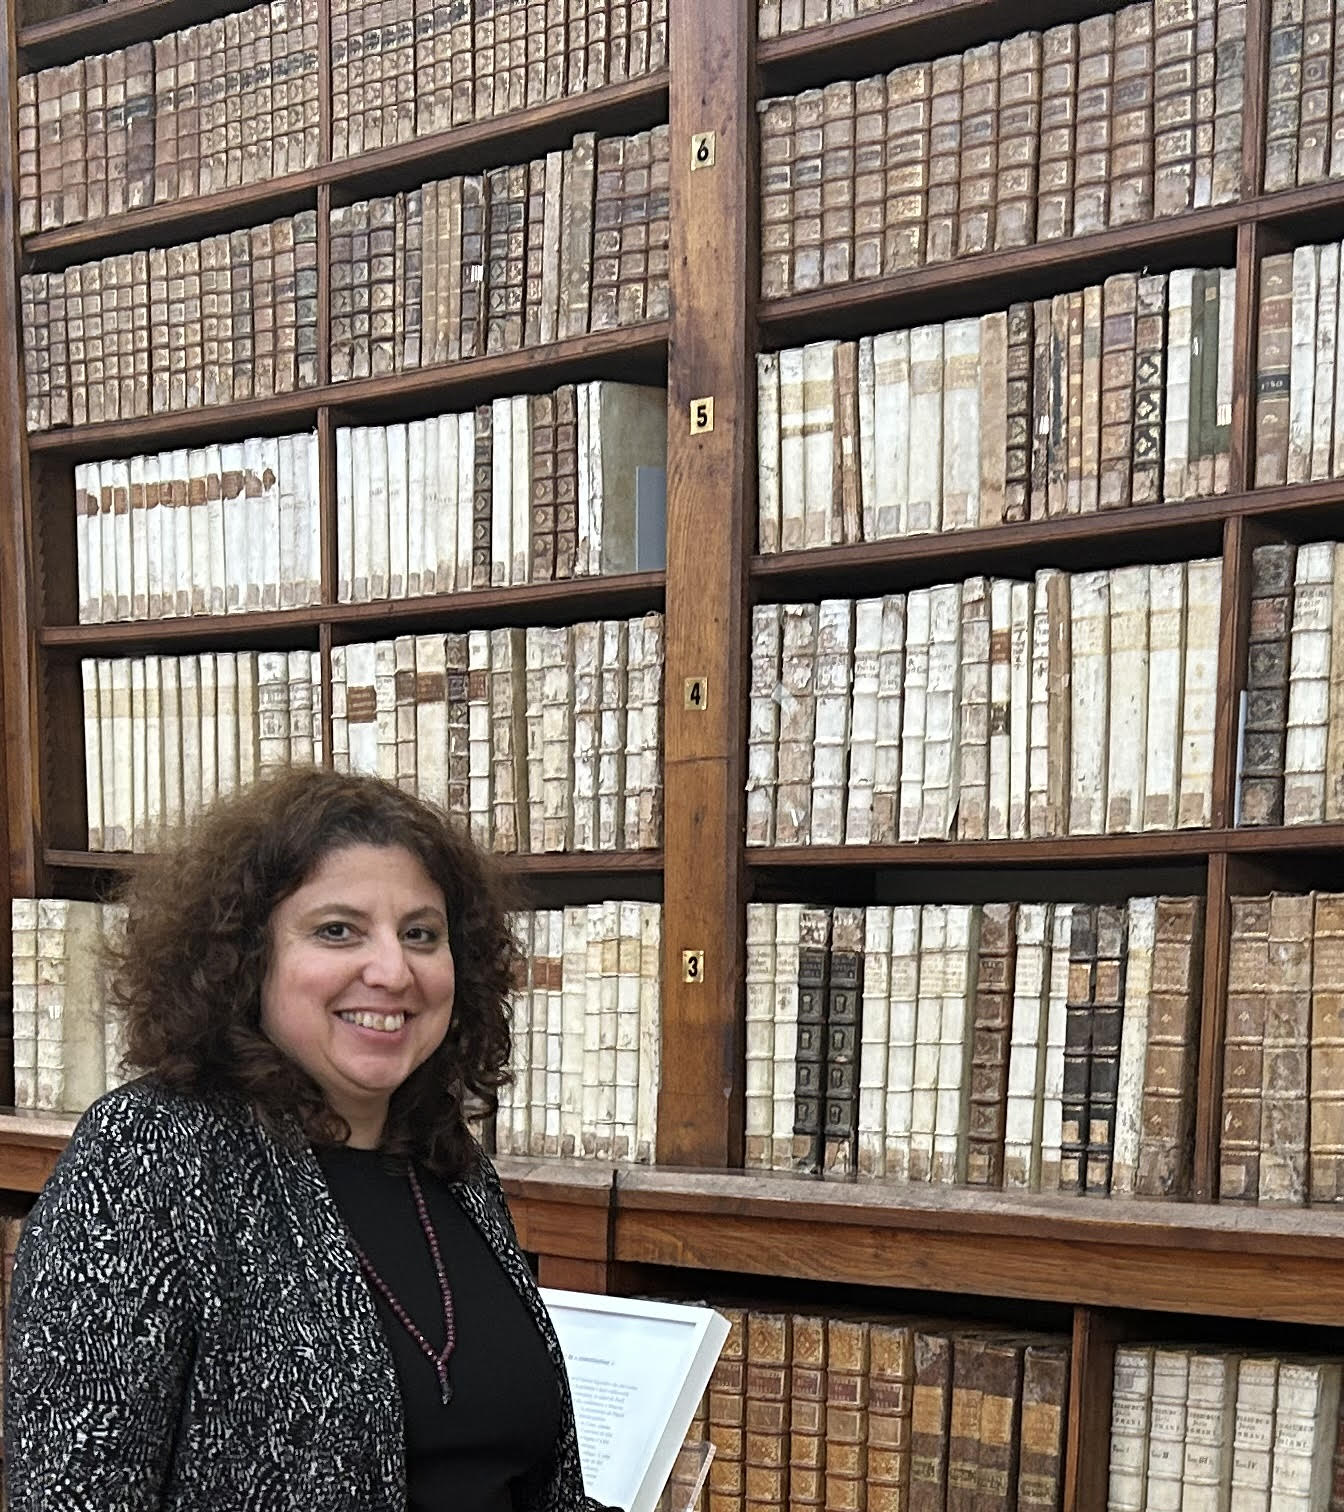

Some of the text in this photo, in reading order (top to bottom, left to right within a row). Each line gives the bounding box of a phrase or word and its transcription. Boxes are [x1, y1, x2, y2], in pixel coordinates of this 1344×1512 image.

[697, 137, 708, 162] 6
[697, 404, 707, 428] 5
[690, 682, 700, 706] 4
[688, 956, 698, 977] 3
